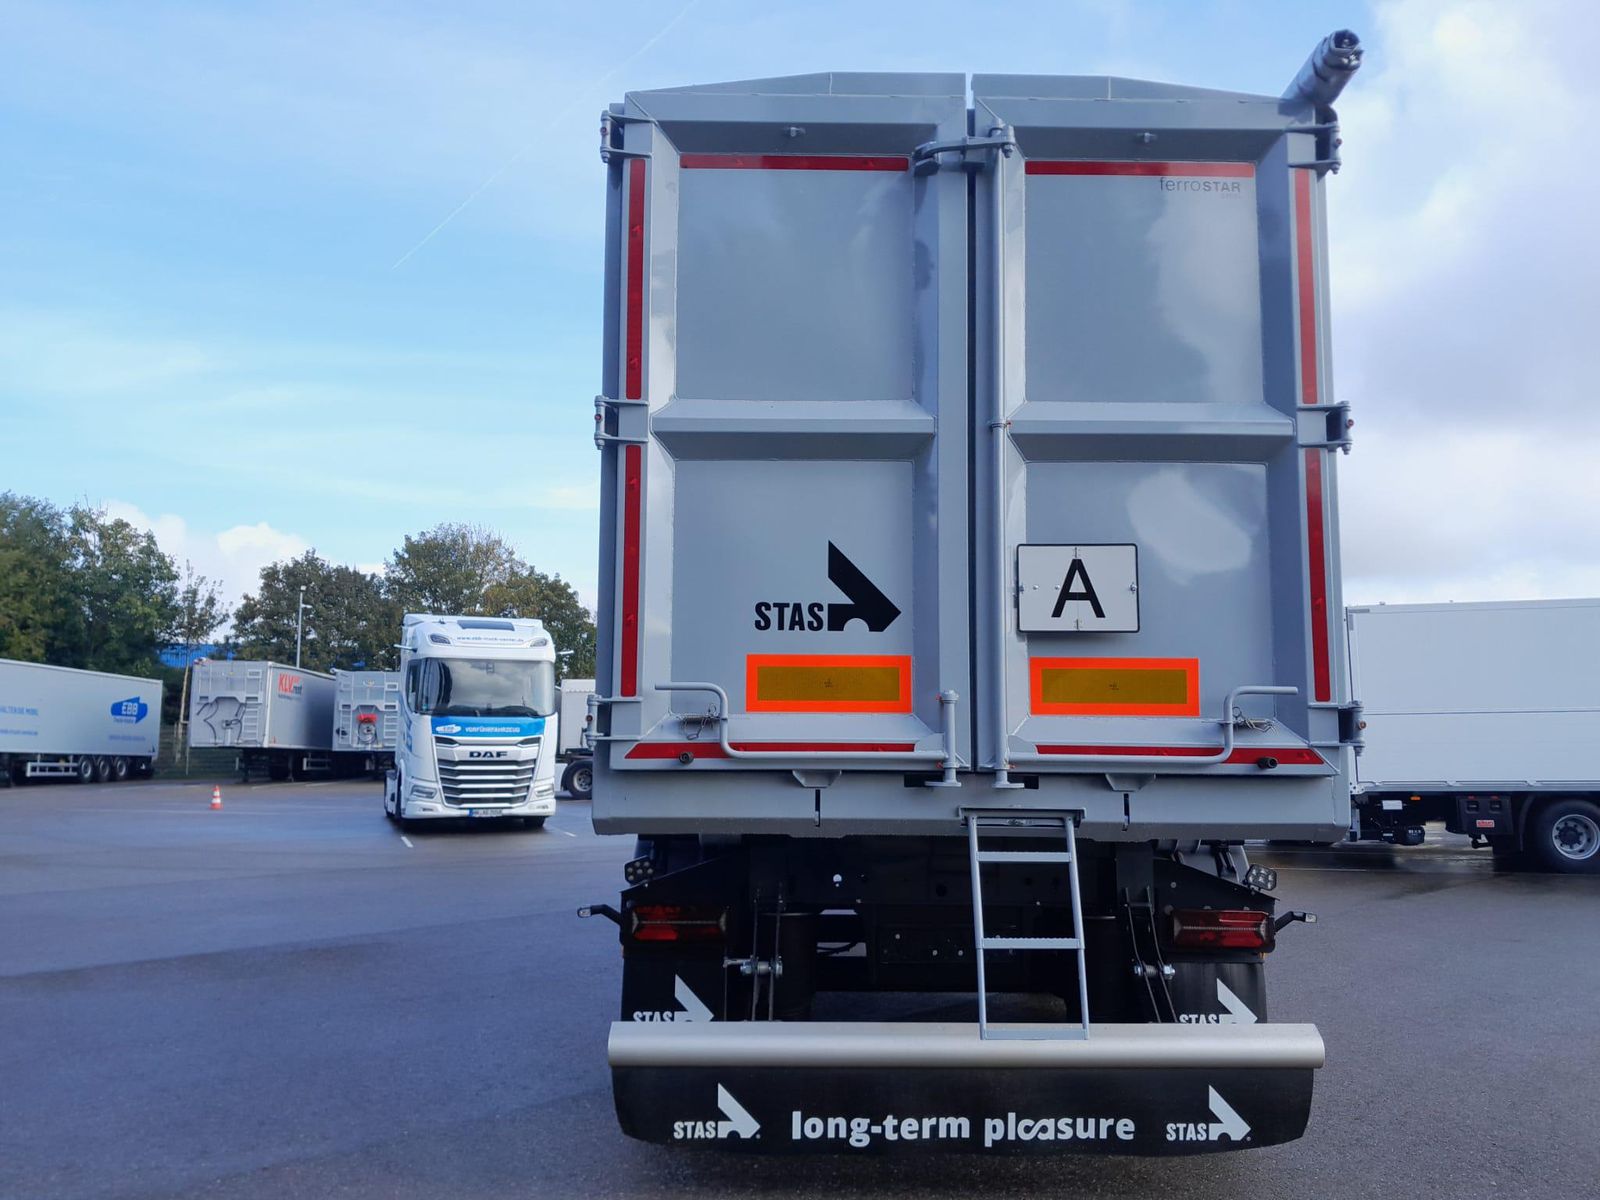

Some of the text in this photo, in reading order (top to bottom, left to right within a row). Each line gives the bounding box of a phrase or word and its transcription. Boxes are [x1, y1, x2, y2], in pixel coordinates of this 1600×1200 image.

[1160, 177, 1241, 192] ferroSTAR
[1051, 558, 1106, 619] A
[754, 601, 824, 632] STAS
[469, 751, 508, 759] DAF
[673, 1120, 716, 1139] STAS
[792, 1111, 1135, 1148] long-term pleasure
[1166, 1122, 1209, 1141] STAS
